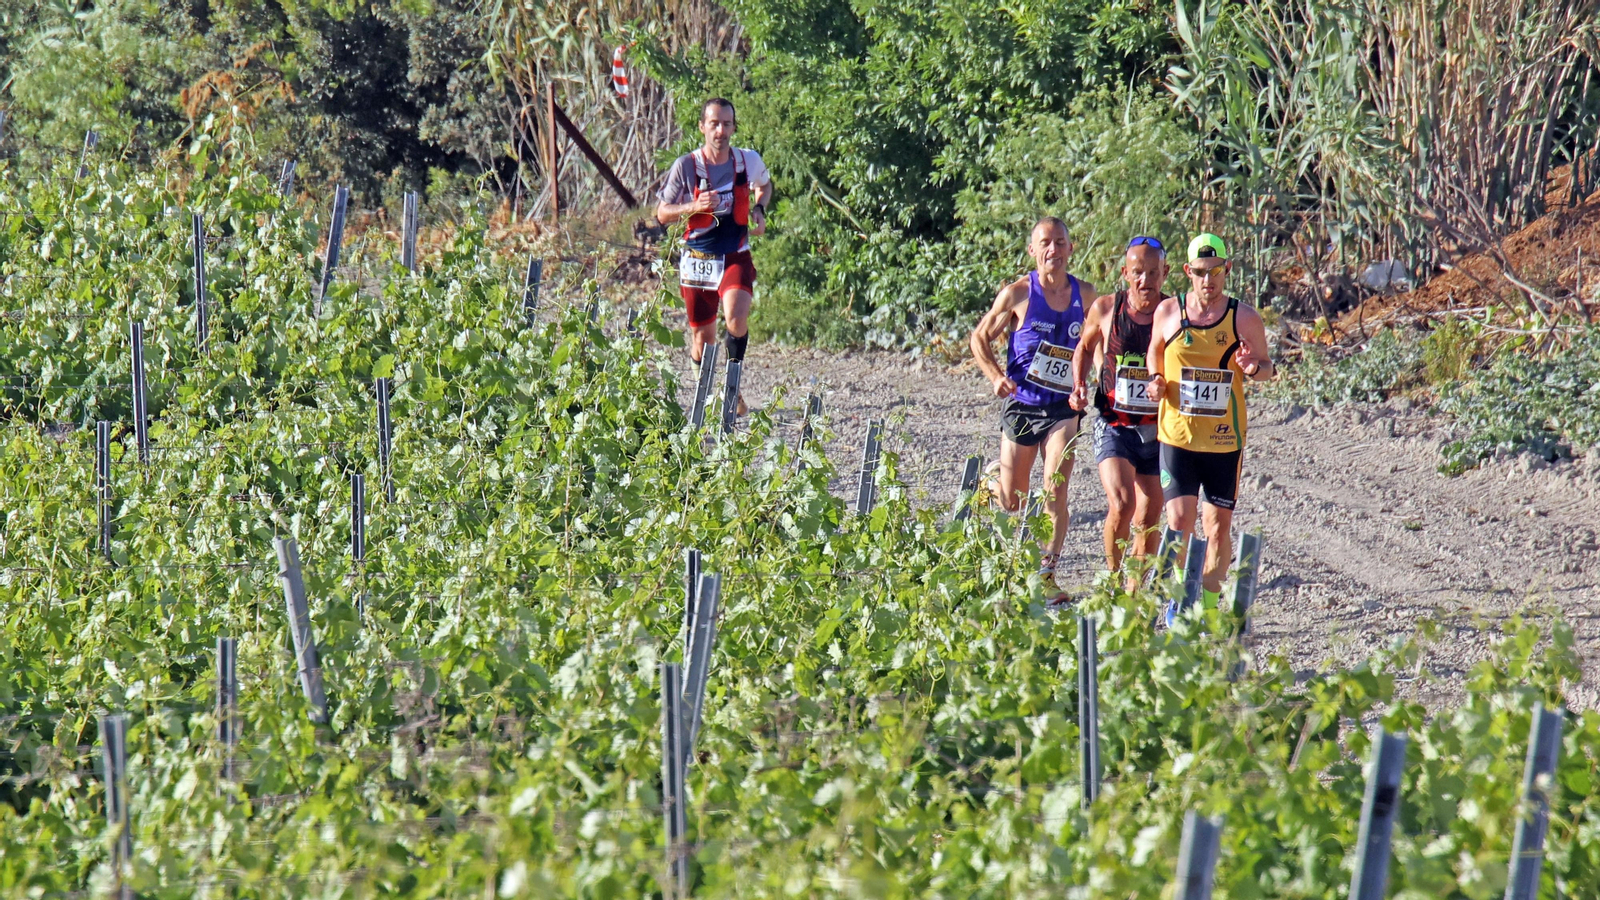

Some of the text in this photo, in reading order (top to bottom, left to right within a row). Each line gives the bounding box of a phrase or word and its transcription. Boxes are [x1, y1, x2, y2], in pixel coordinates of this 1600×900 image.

[691, 260, 713, 276] 199
[1045, 359, 1069, 378] 158
[1195, 370, 1221, 381] Sherry
[1127, 382, 1150, 400] 12
[1192, 384, 1219, 402] 141
